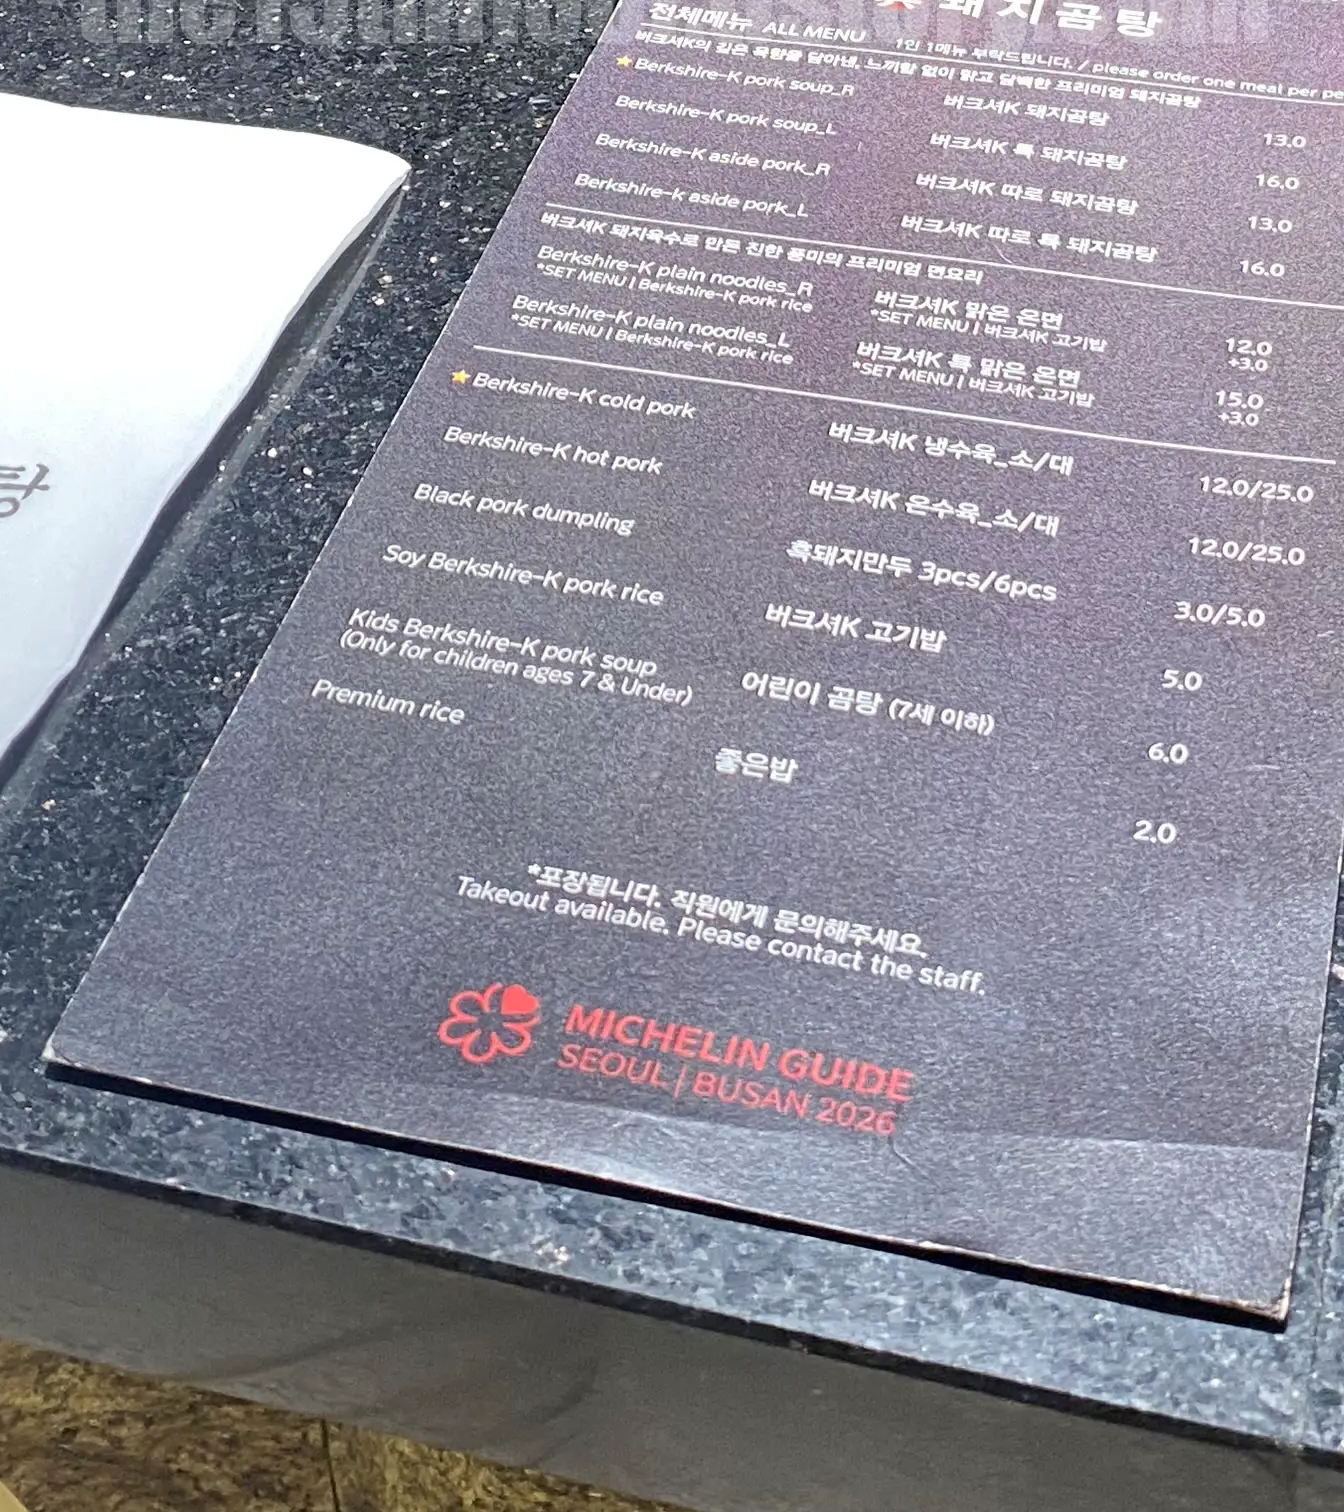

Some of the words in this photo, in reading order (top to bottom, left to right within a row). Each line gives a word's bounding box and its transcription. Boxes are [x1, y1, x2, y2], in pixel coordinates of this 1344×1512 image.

[649, 1, 753, 31] 전체메뉴
[762, 21, 800, 38] ALL
[804, 25, 867, 44] MENU
[743, 75, 787, 89] pork
[1092, 62, 1150, 82] please
[1153, 70, 1201, 85] order
[1203, 77, 1236, 89] one
[1239, 81, 1283, 95] meal
[1287, 87, 1318, 98] per
[725, 112, 770, 128] pork
[944, 94, 1021, 116] 버크셔K
[1024, 103, 1110, 127] 돼지곰탕
[929, 132, 1009, 155] 버크셔K
[1040, 146, 1128, 171] 돼지곰탕
[1263, 132, 1307, 148] 13.0
[708, 151, 760, 167] aside
[915, 173, 996, 197] 버크셔K
[1000, 183, 1044, 202] 따로
[1049, 190, 1139, 216] 돼지곰탕
[1255, 173, 1300, 190] 16.0
[688, 191, 741, 208] aside
[900, 214, 983, 239] 버크셔K
[987, 226, 1031, 245] 따로
[1066, 236, 1159, 263] 돼지곰탕
[1248, 215, 1293, 233] 13.0
[655, 264, 707, 283] plain
[1239, 259, 1285, 277] 16.0
[577, 269, 628, 287] MENU
[737, 294, 778, 308] pork
[780, 298, 814, 313] rice
[633, 314, 685, 333] plain
[874, 290, 960, 316] 버크셔K
[1016, 308, 1064, 331] 온면
[1225, 337, 1273, 357] 12.0
[856, 341, 944, 369] 버크셔K
[1032, 365, 1081, 388] 온면
[1227, 356, 1269, 373] +3.0
[598, 393, 649, 416] cold
[645, 400, 697, 420] pork
[1215, 390, 1264, 411] 15.0
[1218, 411, 1260, 428] +3.0
[828, 421, 919, 452] 버크셔K
[572, 445, 610, 467] hot
[611, 455, 664, 475] pork
[808, 479, 901, 511] 버크셔K
[1199, 475, 1314, 503] 12.0/25.0
[413, 483, 476, 508] Black
[476, 496, 530, 518] pork
[532, 502, 636, 537] dumpling
[1188, 536, 1306, 566] 12.0/25.0
[382, 544, 427, 569] Soy
[562, 577, 617, 599] pork
[620, 582, 665, 606] rice
[917, 560, 1057, 602] 3pcs/6pcs
[765, 603, 862, 638] 버크셔K
[864, 620, 948, 653] 고기밥
[1173, 600, 1266, 628] 3.0/5.0
[348, 607, 400, 633] Kids
[540, 644, 597, 667] pork
[599, 654, 658, 678] soup
[340, 628, 397, 657] (Only
[398, 639, 432, 660] for
[433, 647, 519, 676] children
[522, 664, 574, 685] ages
[621, 676, 693, 707] Under)
[1161, 669, 1203, 692] 5.0
[311, 678, 416, 716] Premium
[419, 699, 465, 725] rice
[741, 671, 821, 706] 어린이
[827, 685, 884, 716] 곰탕
[888, 698, 936, 726] (7세
[940, 708, 995, 736] 이하)
[1148, 742, 1189, 765] 6.0
[1133, 819, 1177, 844] 2.0
[458, 875, 550, 912] Takeout
[554, 898, 669, 935] available.
[677, 916, 762, 951] Please
[767, 939, 864, 972] contact
[871, 953, 914, 980] the
[918, 965, 985, 996] staff.
[670, 889, 769, 929] 직원에게
[773, 909, 928, 959] 문의해주세요.
[564, 1004, 771, 1073] MICHELIN
[777, 1048, 913, 1103] GUIDE
[559, 1044, 664, 1087] SEOUL
[692, 1071, 809, 1117] BUSAN
[816, 1099, 895, 1134] 2026
